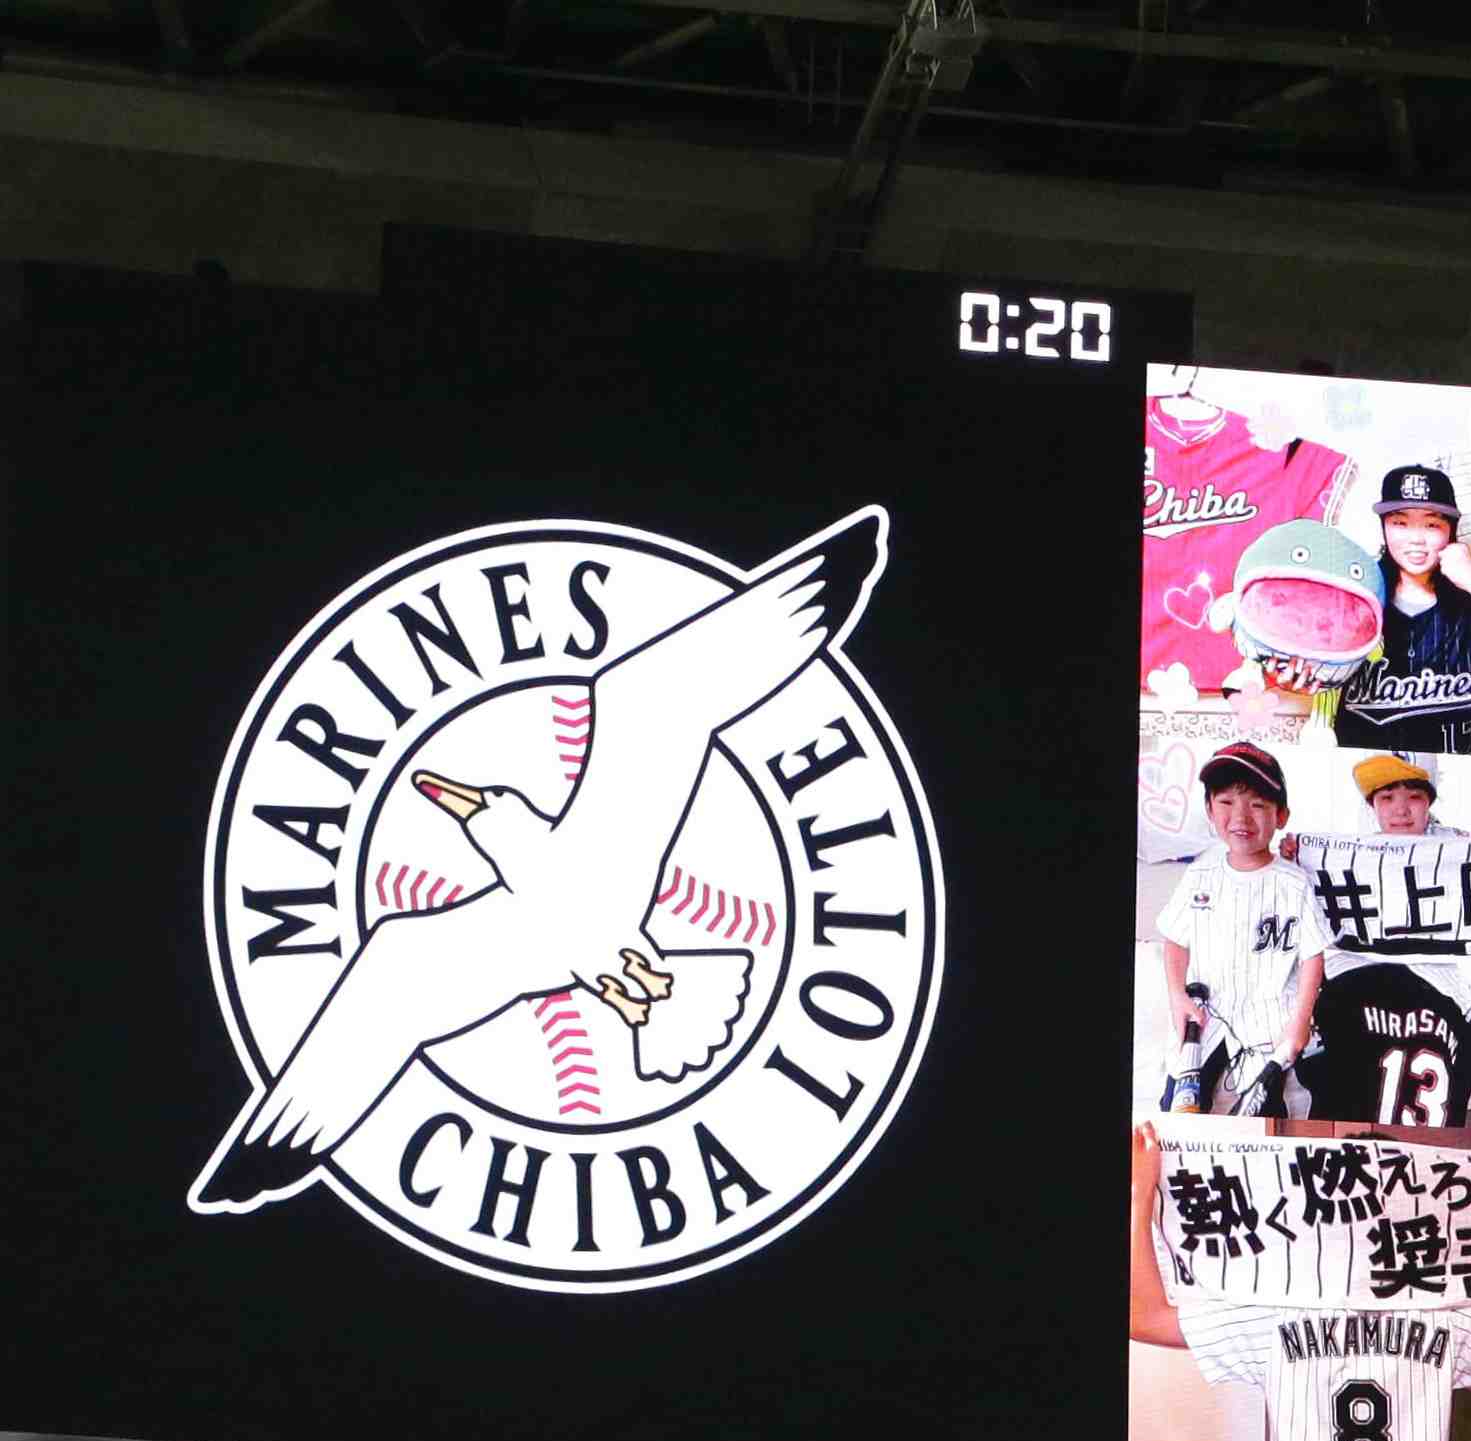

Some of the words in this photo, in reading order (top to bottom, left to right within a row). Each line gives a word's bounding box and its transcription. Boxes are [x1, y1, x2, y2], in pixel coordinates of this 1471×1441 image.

[958, 291, 1111, 362] 0:20
[1142, 483, 1258, 528] Chiba
[241, 558, 612, 964] MARINES
[399, 1110, 774, 1253] CHIBA
[765, 713, 909, 1120] LOTTE
[1376, 1046, 1450, 1128] 13
[1278, 1317, 1450, 1369] NAKAMURA
